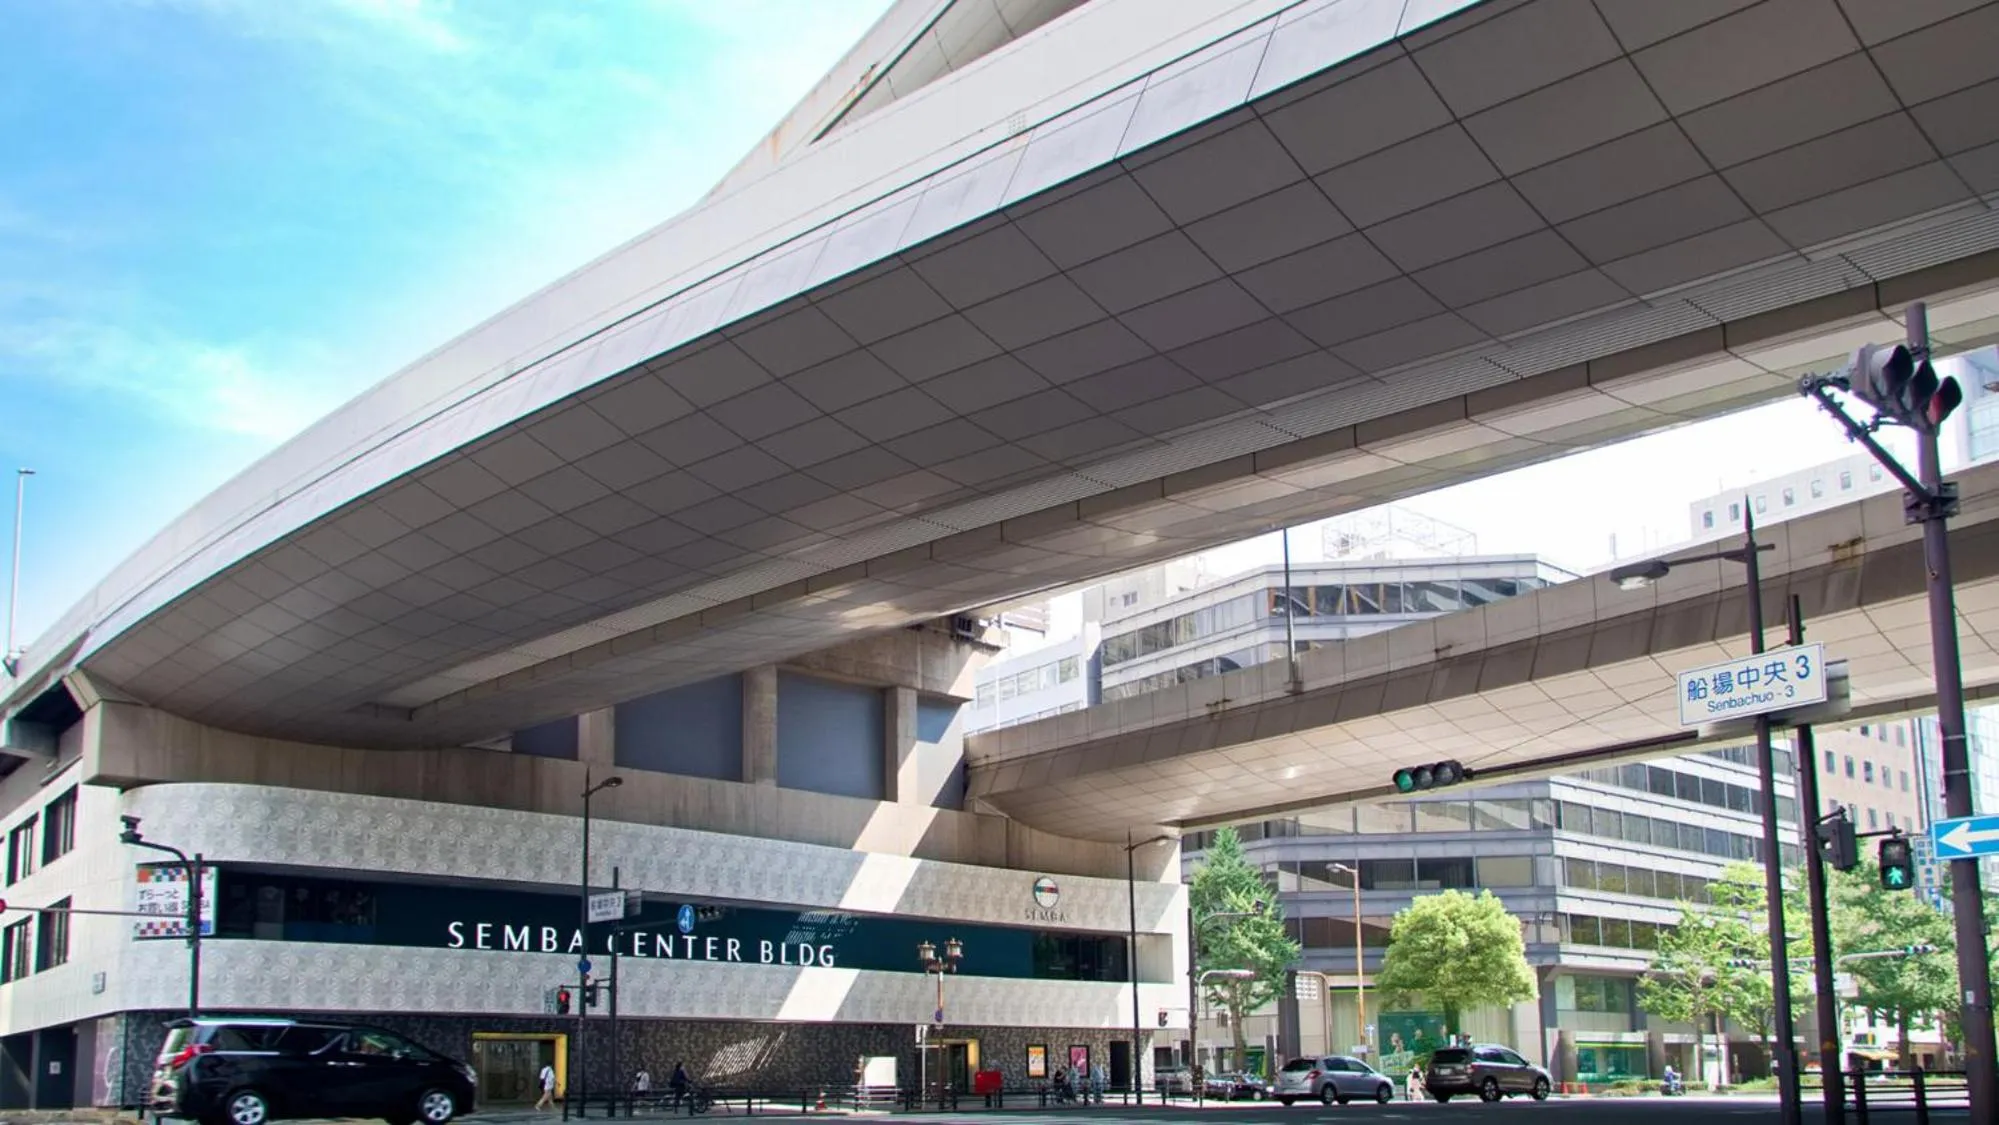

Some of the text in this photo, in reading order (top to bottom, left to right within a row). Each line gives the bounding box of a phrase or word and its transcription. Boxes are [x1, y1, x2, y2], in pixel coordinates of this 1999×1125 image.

[1707, 690, 1775, 713] Senbachuo
[1785, 684, 1795, 698] 3
[448, 921, 584, 953] SEMBA
[760, 940, 835, 968] BLDG
